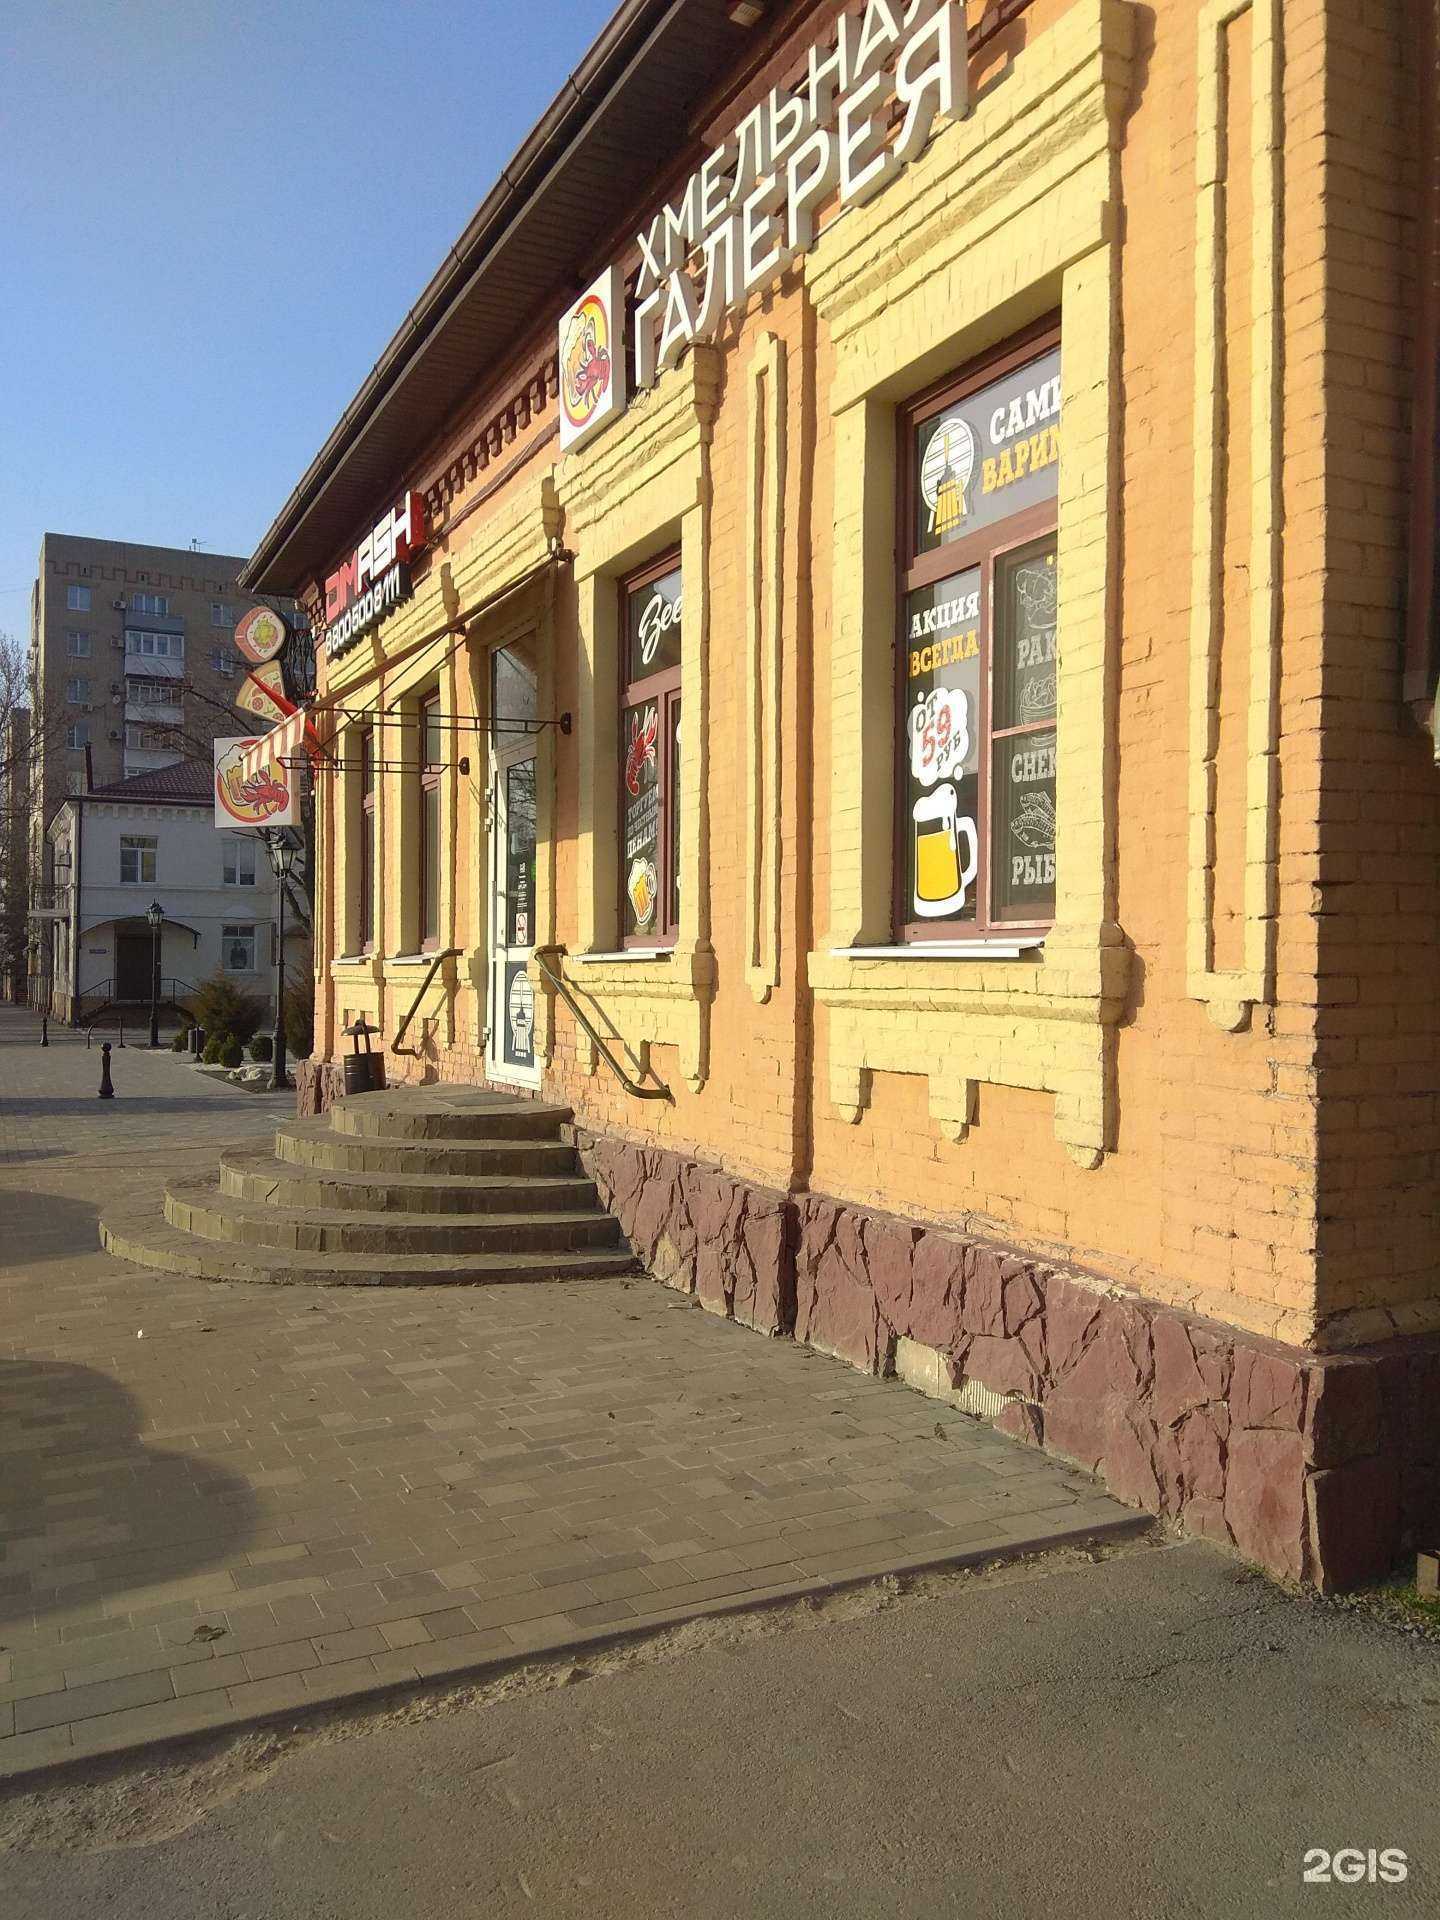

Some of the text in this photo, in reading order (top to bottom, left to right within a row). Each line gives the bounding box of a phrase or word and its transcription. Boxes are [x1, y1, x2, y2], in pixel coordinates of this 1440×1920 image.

[634, 0, 963, 299] ХМЕЛЬНА
[634, 1, 954, 387] ГАЛЕРЕЯ
[910, 591, 979, 639] АКЦИЯ
[909, 629, 980, 677] ВСЕГДА
[922, 703, 952, 768] 59
